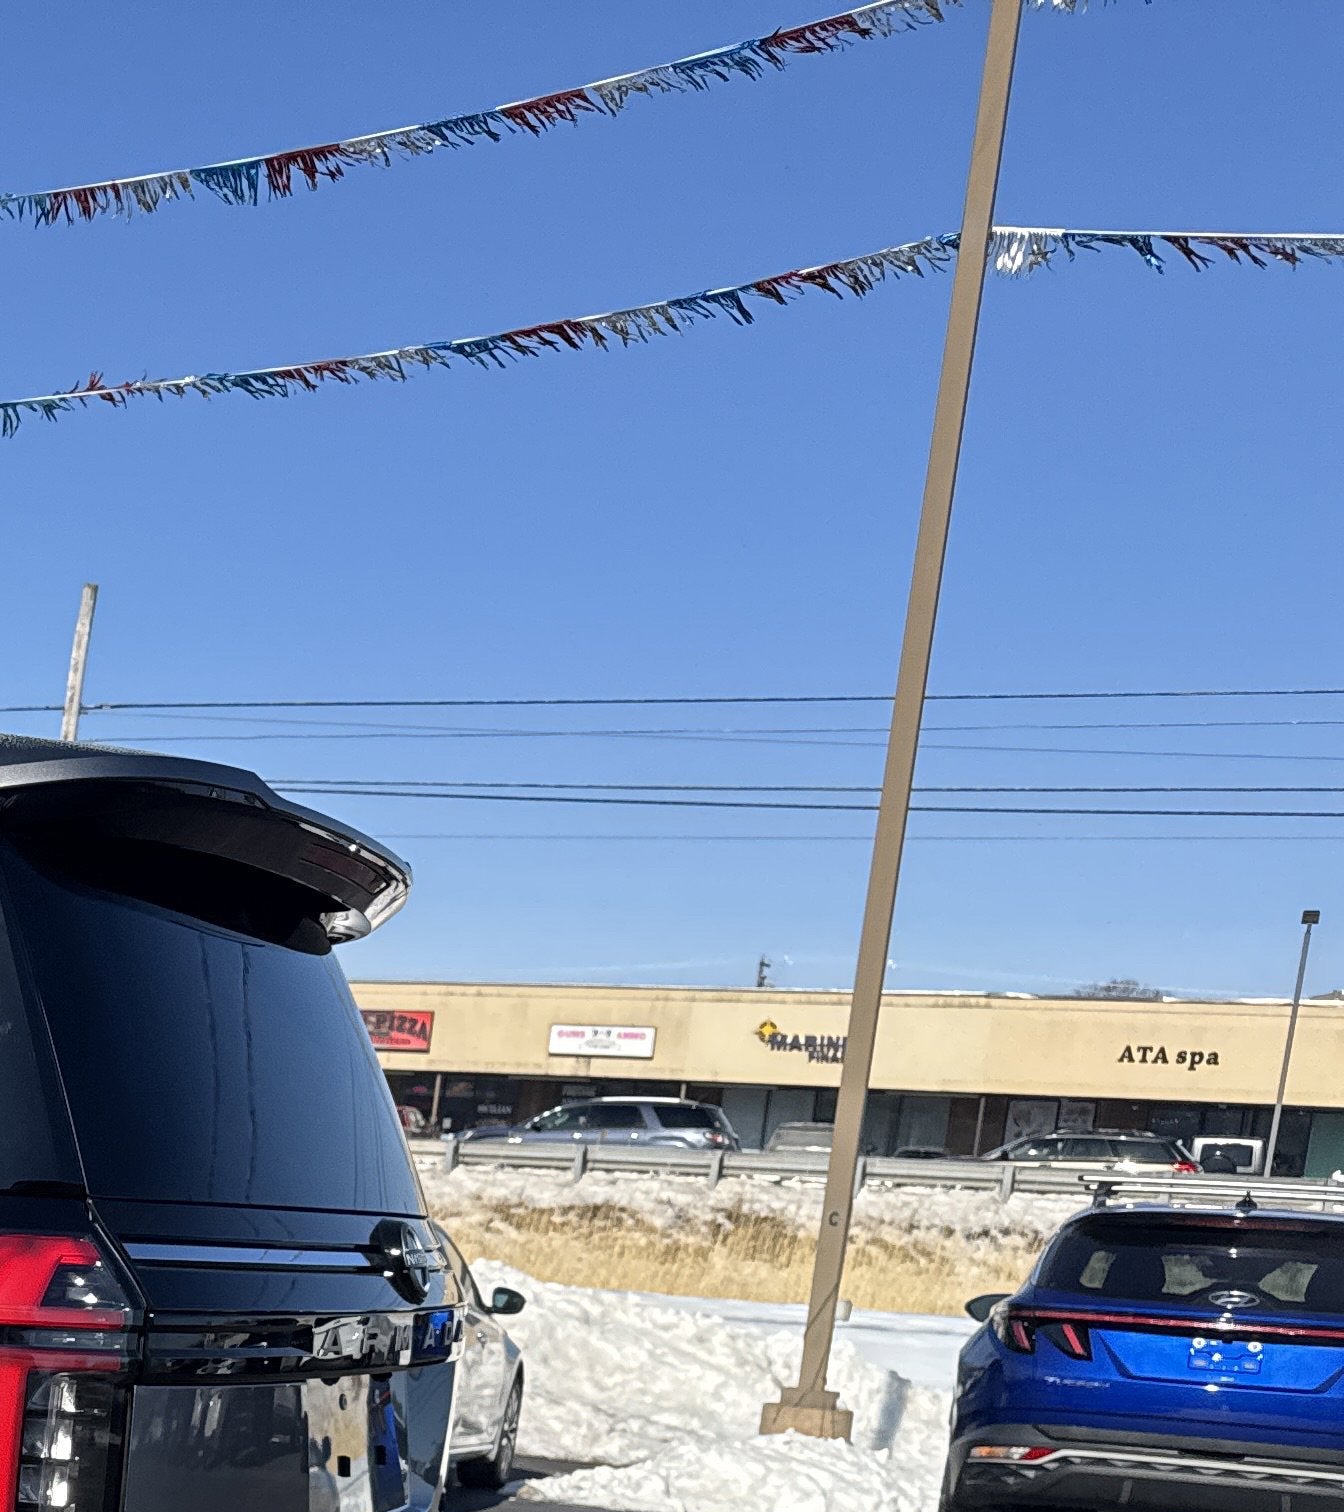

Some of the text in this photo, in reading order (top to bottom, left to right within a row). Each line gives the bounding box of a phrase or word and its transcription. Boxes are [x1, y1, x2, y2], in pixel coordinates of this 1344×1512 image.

[1117, 1045, 1220, 1072] ATA spa
[318, 1319, 463, 1359] ARMADA
